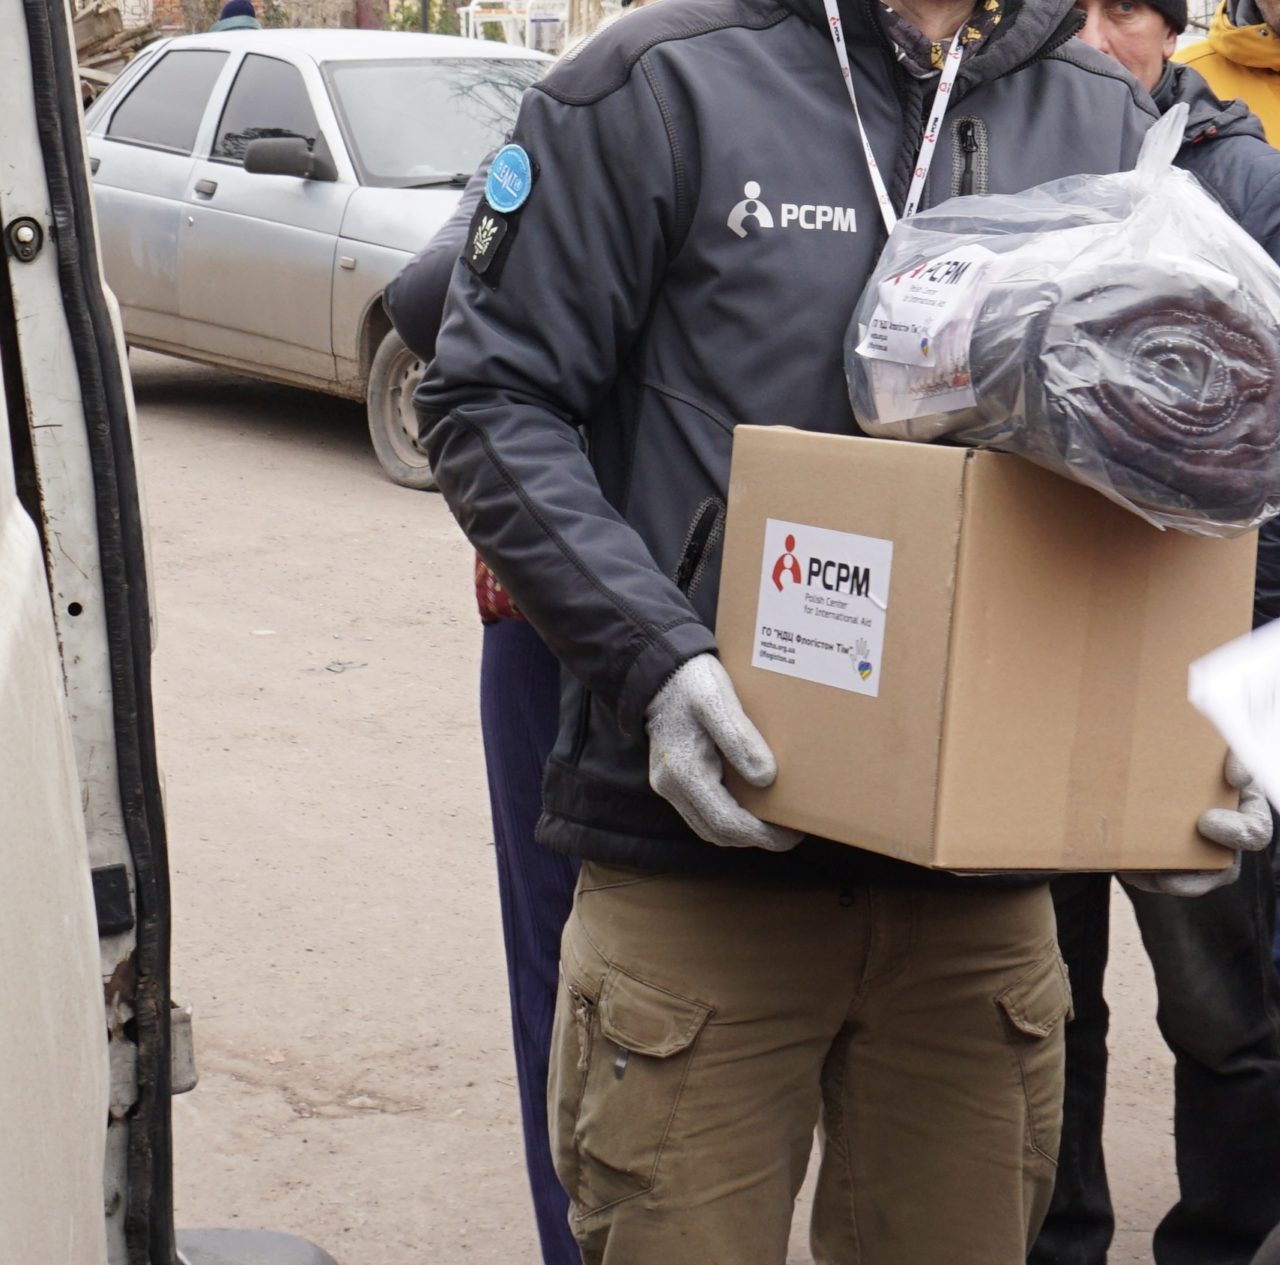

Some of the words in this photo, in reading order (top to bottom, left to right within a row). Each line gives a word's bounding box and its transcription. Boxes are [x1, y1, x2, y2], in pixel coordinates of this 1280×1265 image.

[781, 203, 857, 233] PCPM
[918, 261, 971, 284] PCPM
[807, 557, 870, 597] PCPM
[805, 594, 824, 604] Polish
[826, 597, 848, 609] Center
[804, 606, 813, 615] for
[815, 608, 858, 624] International
[861, 618, 872, 627] Aid
[762, 626, 772, 636] ГО
